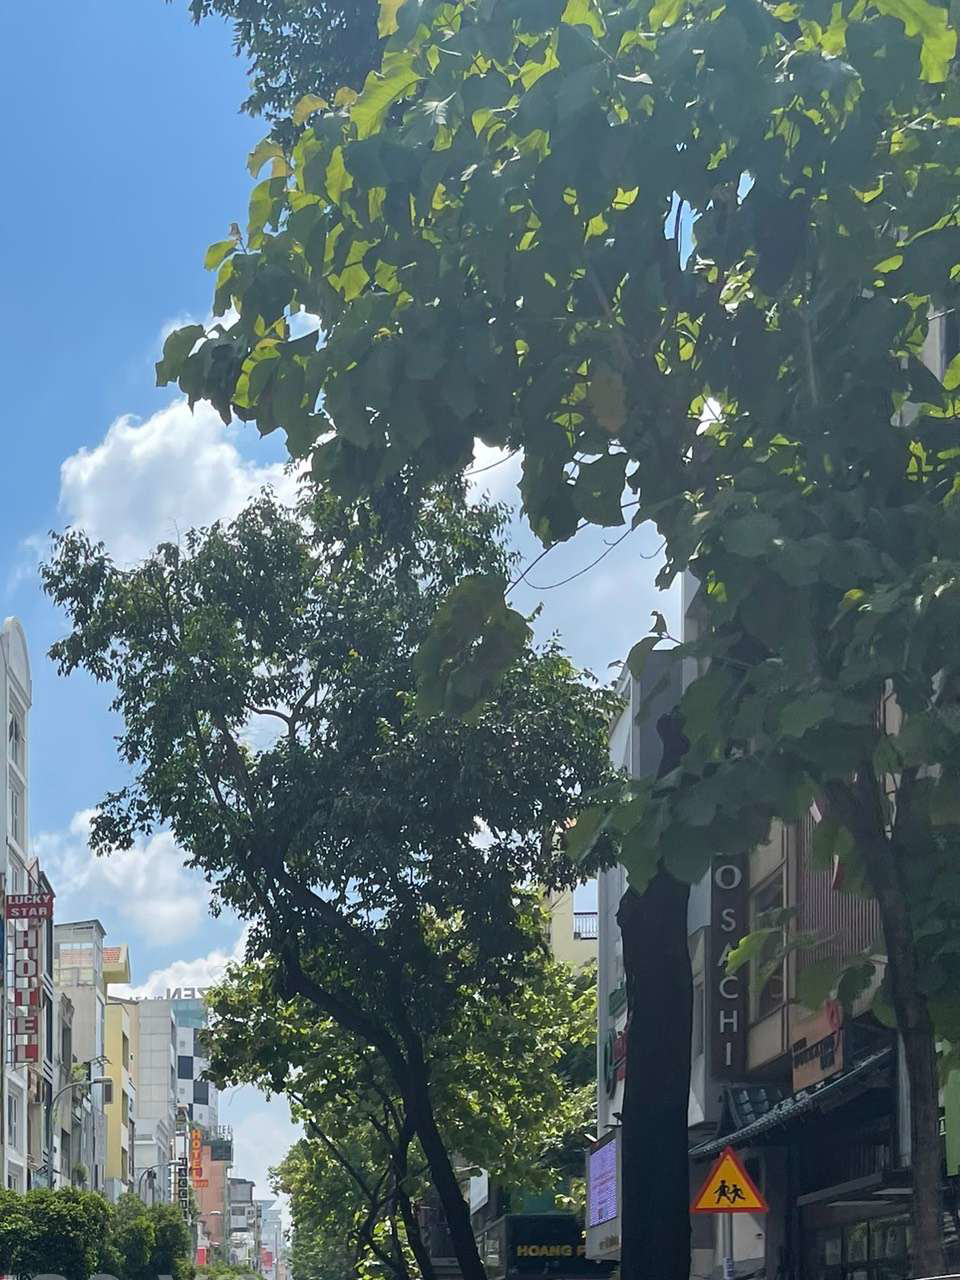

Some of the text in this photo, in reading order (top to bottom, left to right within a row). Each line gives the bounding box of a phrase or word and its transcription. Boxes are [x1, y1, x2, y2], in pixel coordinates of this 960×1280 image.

[8, 895, 51, 905] LUCKY
[11, 907, 48, 917] STAR
[15, 929, 36, 1062] HOTEL
